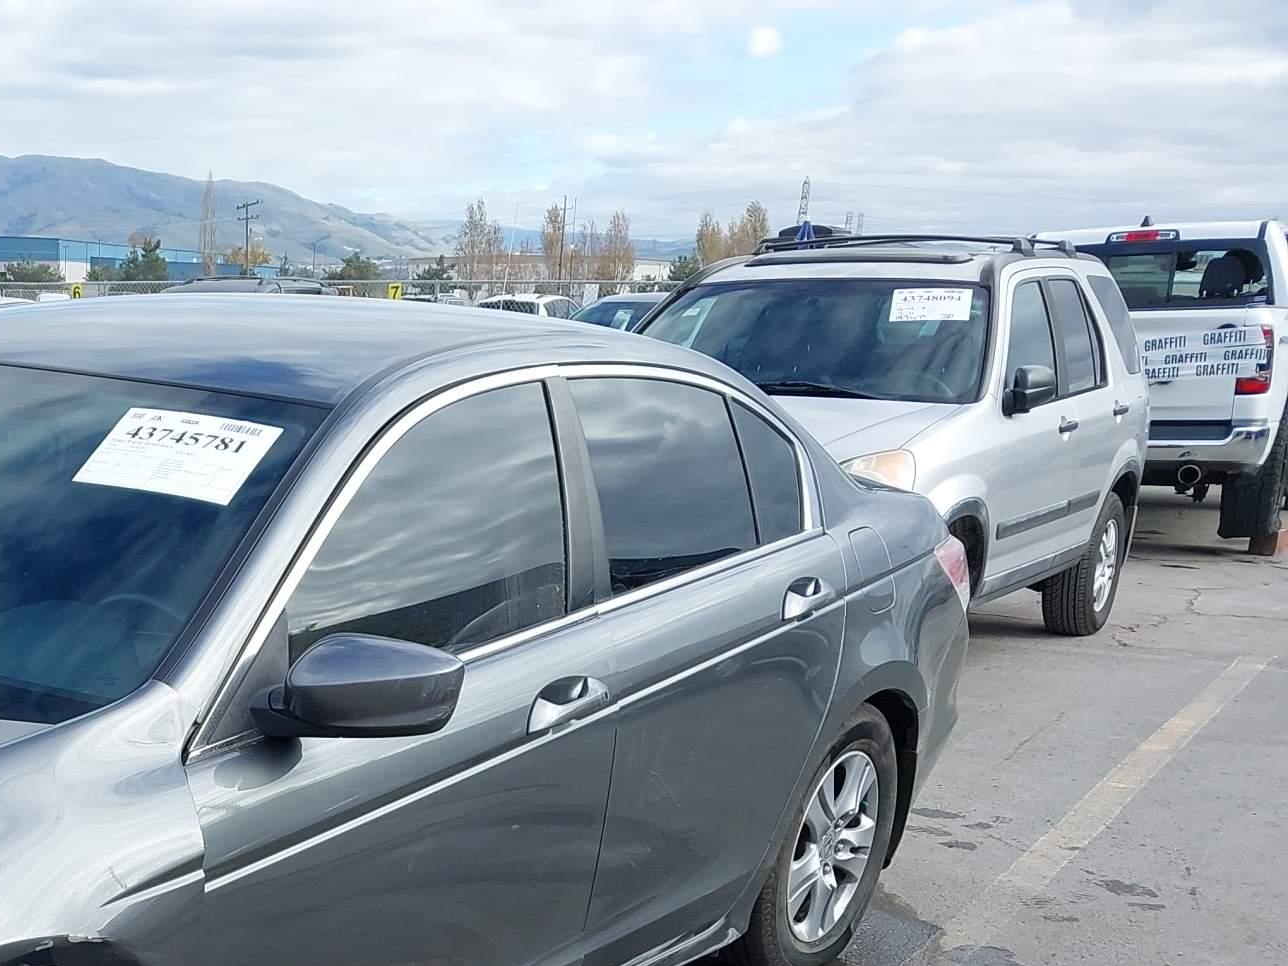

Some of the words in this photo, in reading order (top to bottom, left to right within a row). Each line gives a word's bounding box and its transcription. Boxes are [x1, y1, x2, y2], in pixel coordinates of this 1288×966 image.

[73, 285, 81, 299] 6
[390, 285, 400, 299] 7
[1144, 336, 1186, 352] GRAFFITI
[1203, 330, 1247, 345] GRAFFITI
[1164, 352, 1207, 365] GRAFFITI
[1144, 366, 1179, 379] RAFFITI
[1195, 363, 1239, 377] GRAFFITI
[125, 425, 247, 453] 43745781
